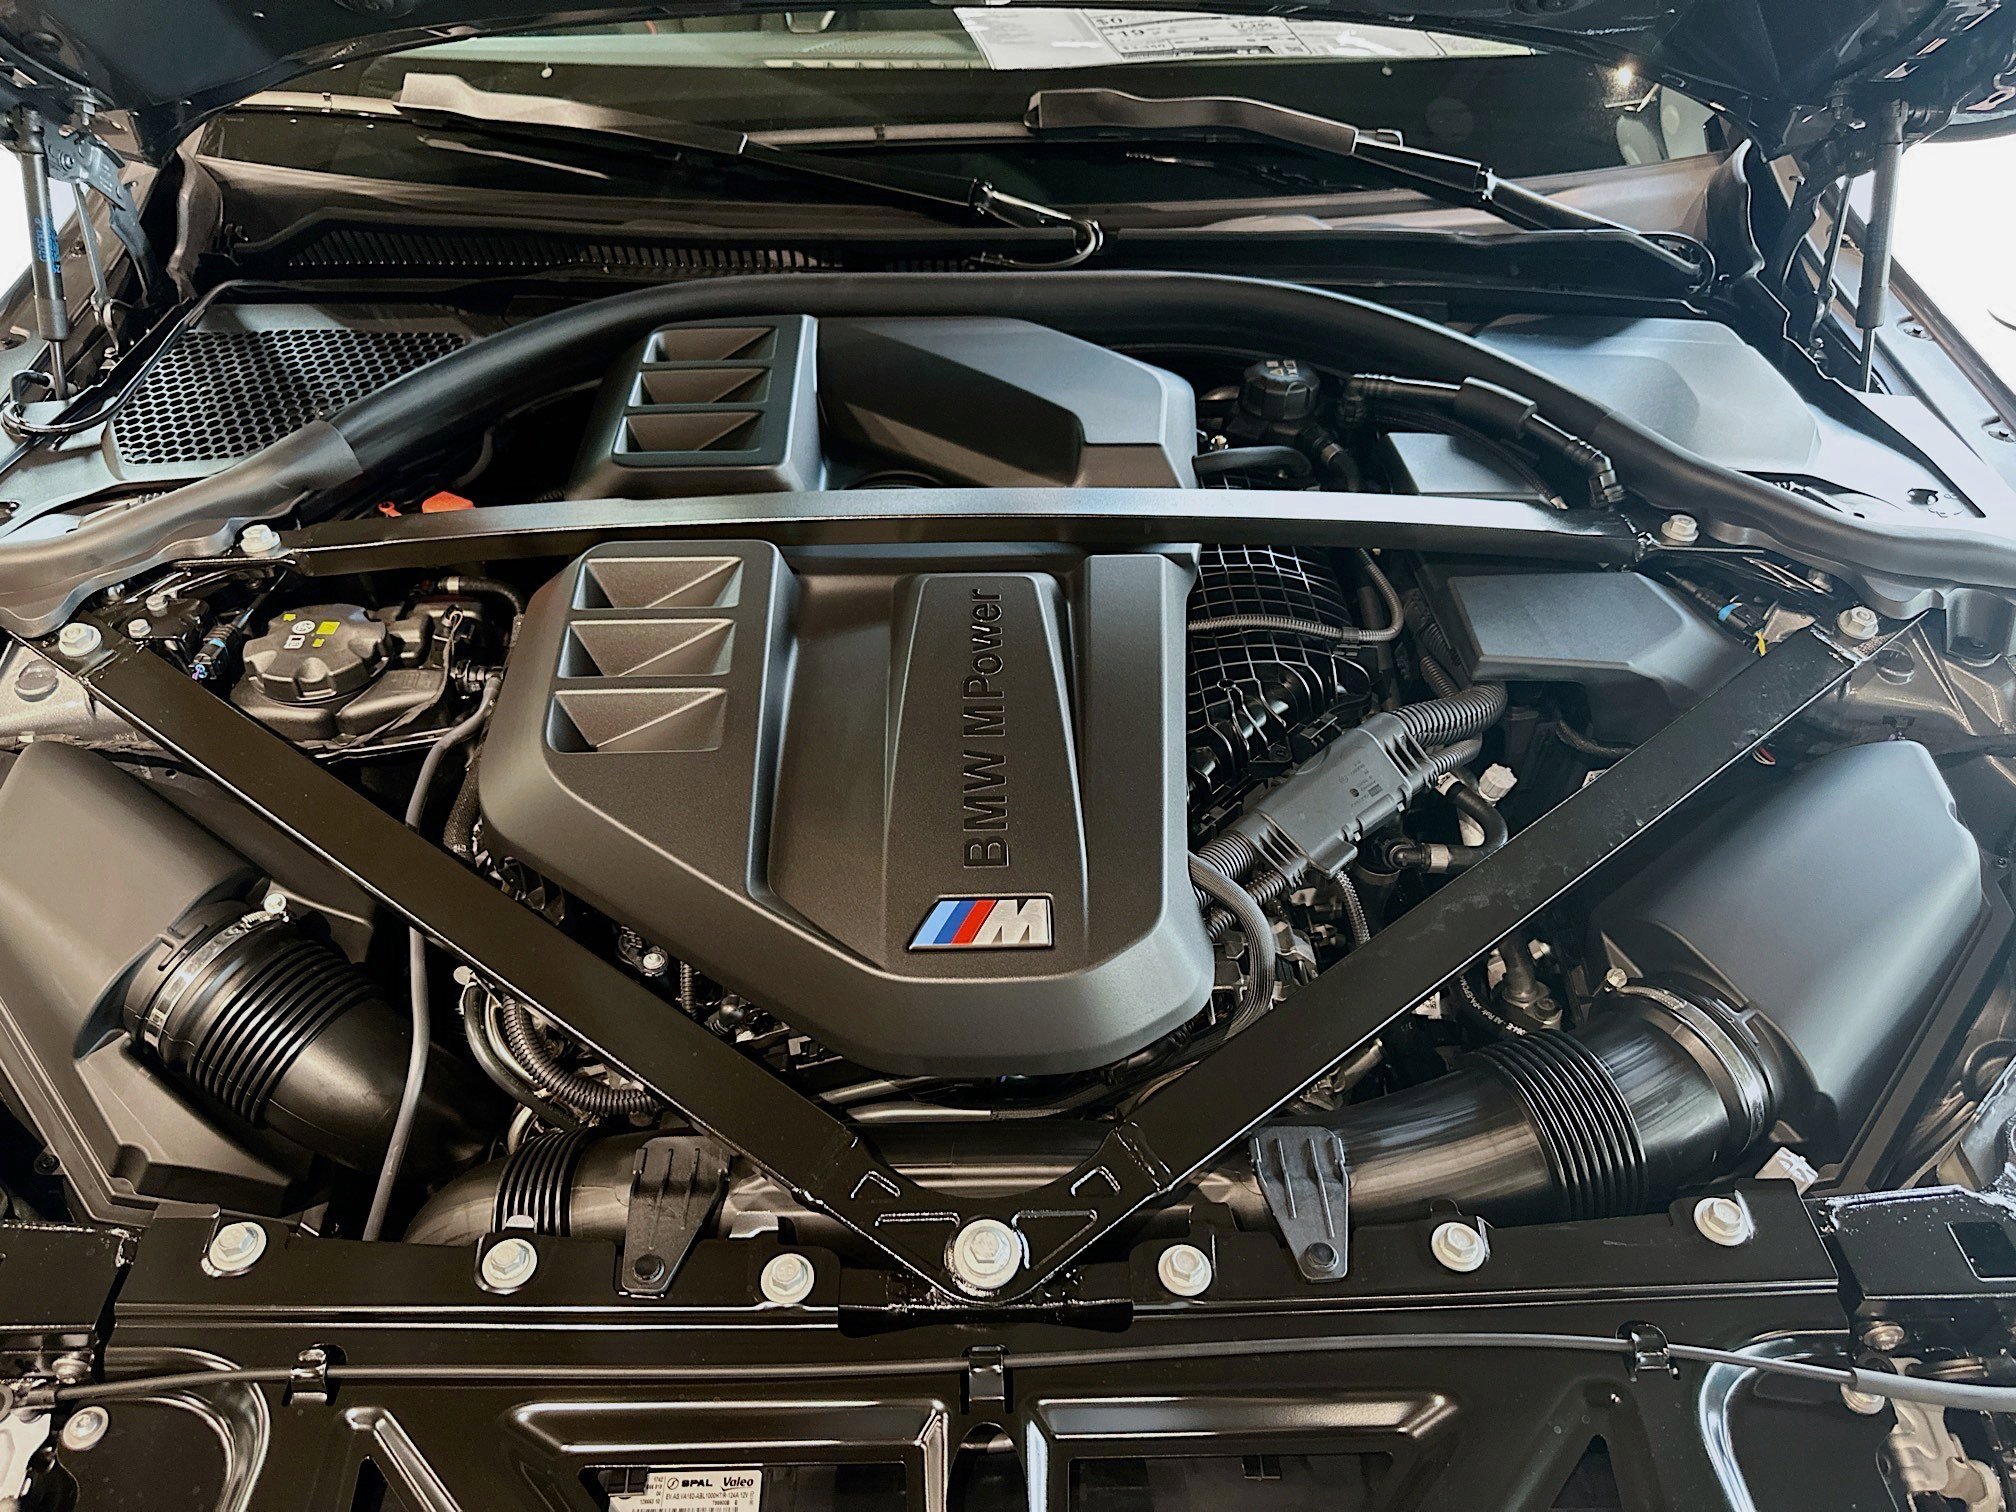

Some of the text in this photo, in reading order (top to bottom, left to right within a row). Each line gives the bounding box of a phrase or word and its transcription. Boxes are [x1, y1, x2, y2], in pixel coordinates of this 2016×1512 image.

[962, 749, 1009, 869] BMW
[970, 899, 1049, 945] M
[681, 1477, 753, 1487] SPAL Valeo
